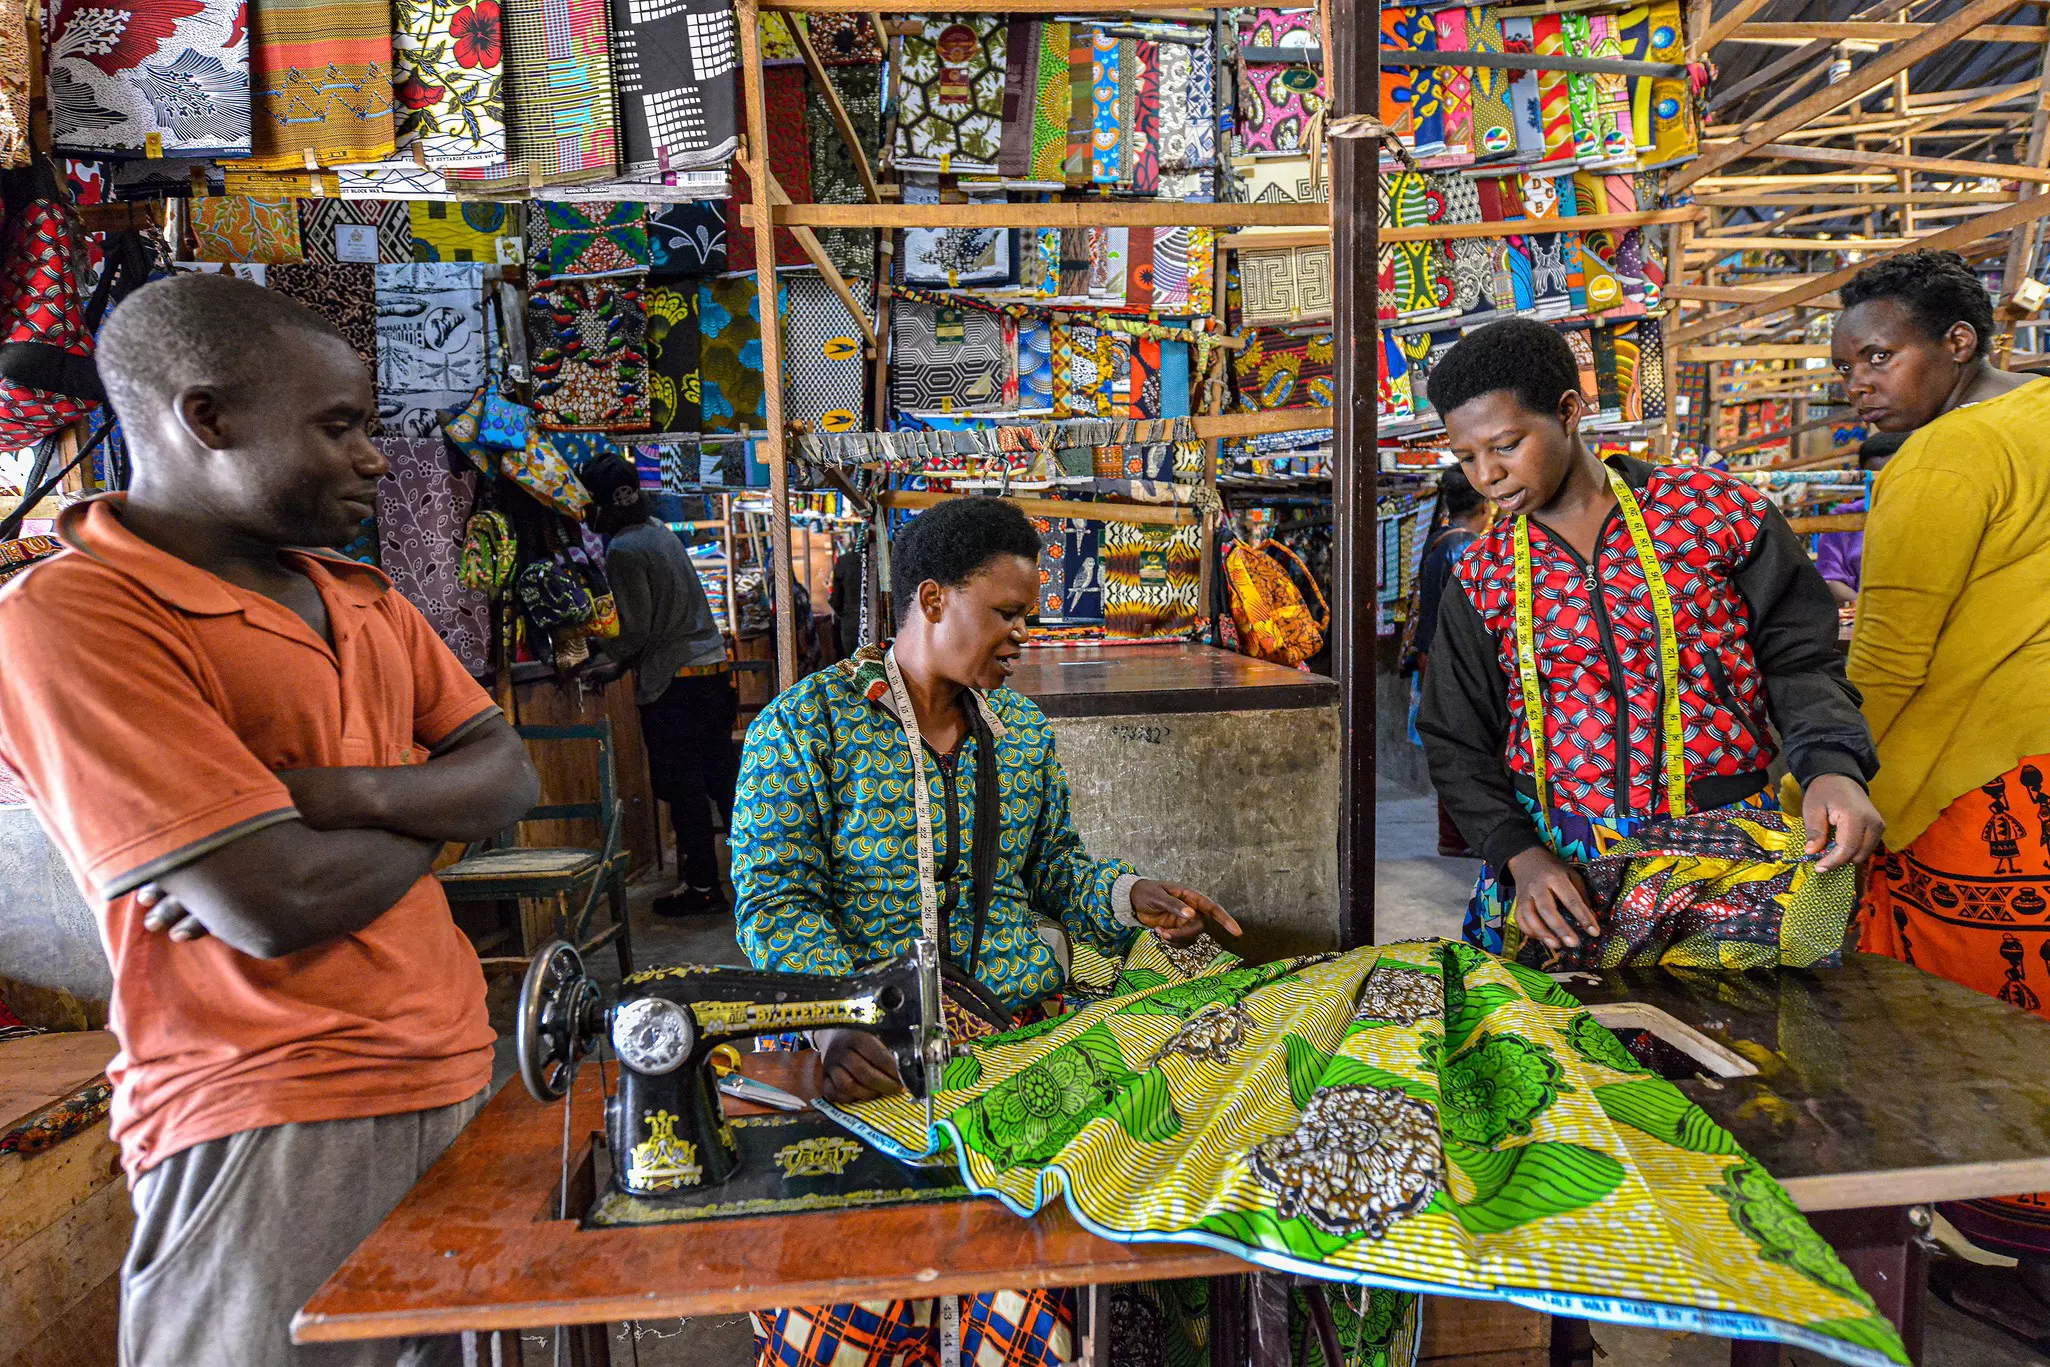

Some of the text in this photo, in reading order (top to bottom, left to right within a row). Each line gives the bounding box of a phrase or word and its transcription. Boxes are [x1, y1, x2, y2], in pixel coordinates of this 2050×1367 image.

[1532, 178, 1541, 189] D
[1535, 201, 1544, 213] B
[1628, 506, 1638, 516] 20
[1634, 522, 1644, 532] 19
[1640, 538, 1650, 548] 18
[1646, 555, 1655, 564] 17
[1652, 572, 1660, 581] 16
[1657, 590, 1666, 600] 15
[1519, 598, 1526, 608] 37
[1662, 608, 1670, 619] 14
[1666, 628, 1672, 639] 13
[1520, 634, 1527, 645] 39
[1668, 647, 1675, 659] 12
[886, 661, 894, 671] 12
[891, 676, 898, 686] 13
[1527, 690, 1535, 702] 42
[900, 706, 908, 714] 15
[1530, 708, 1538, 720] 43
[905, 720, 914, 729] 16
[1532, 728, 1540, 740] 44
[910, 736, 917, 745] 17
[918, 808, 926, 818] 21
[920, 827, 927, 838] 22
[920, 846, 928, 859] 23
[922, 866, 928, 878] 24
[924, 886, 932, 898] 25
[924, 906, 932, 920] 26
[944, 1304, 952, 1320] 43
[944, 1331, 952, 1347] 44
